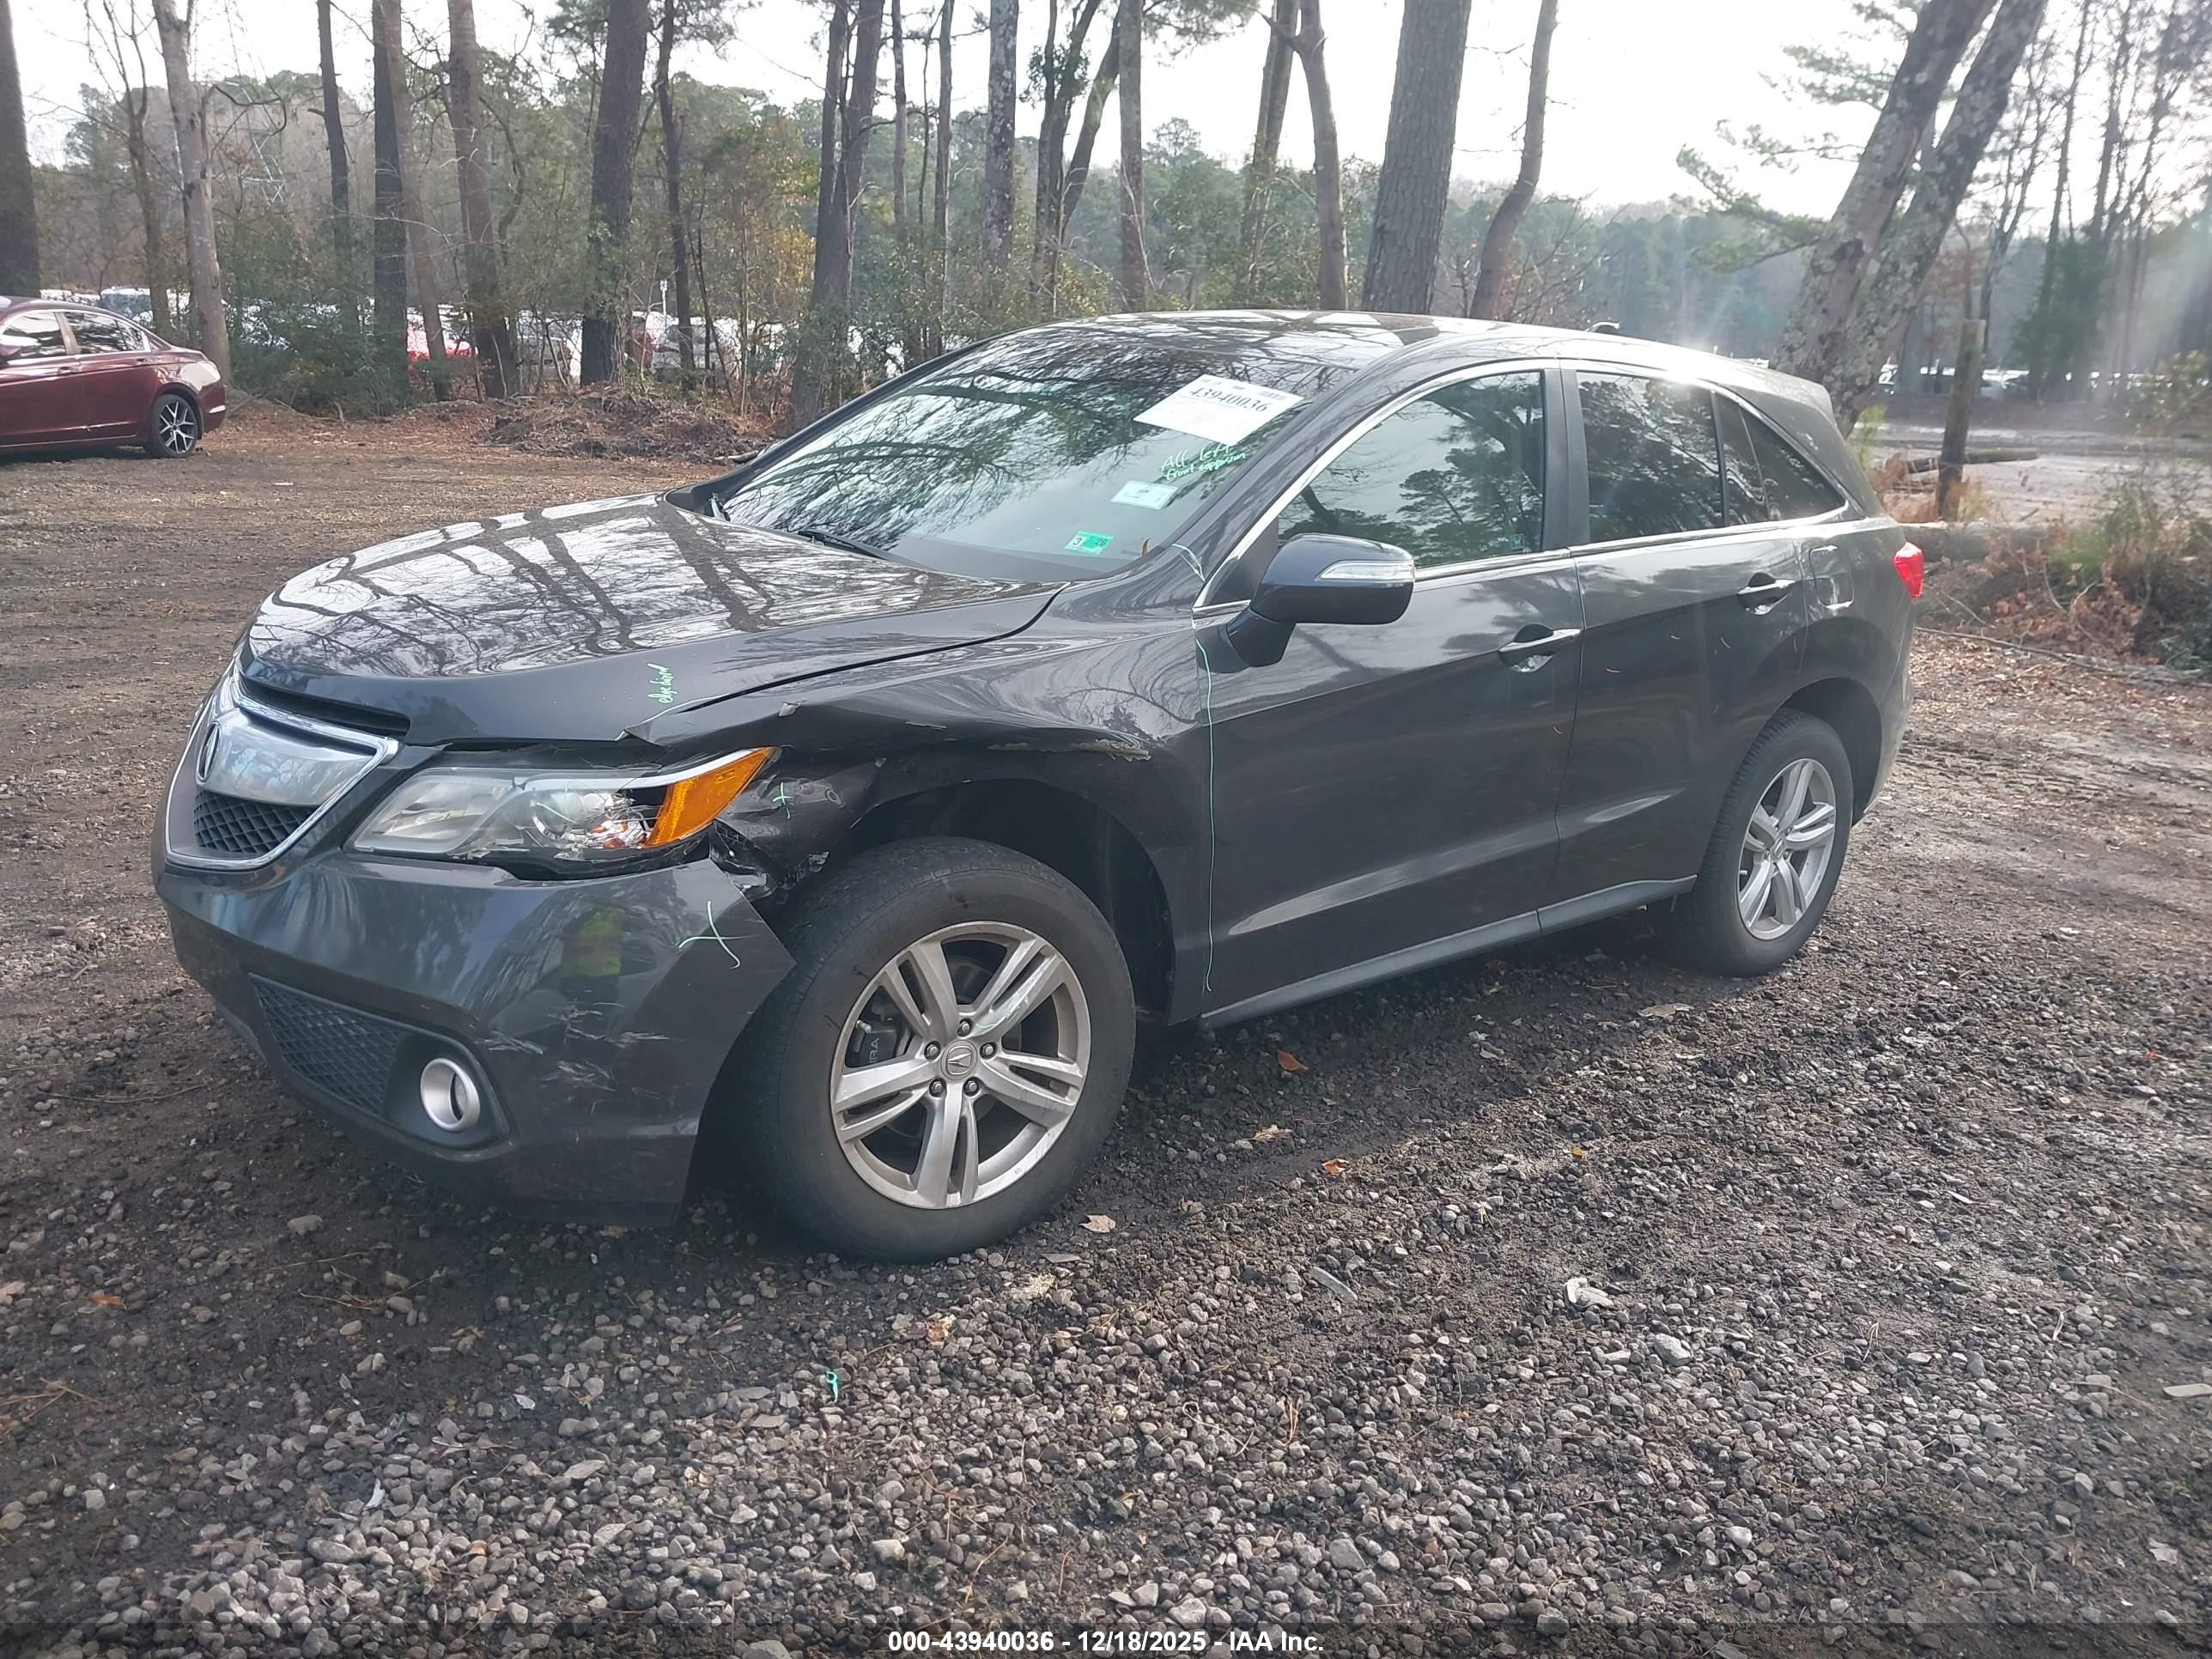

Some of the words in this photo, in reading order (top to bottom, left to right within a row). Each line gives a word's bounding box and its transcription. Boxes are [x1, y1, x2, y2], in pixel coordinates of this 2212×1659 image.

[1189, 387, 1271, 411] 43940036
[1165, 464, 1194, 480] front
[1073, 537, 1082, 546] 3
